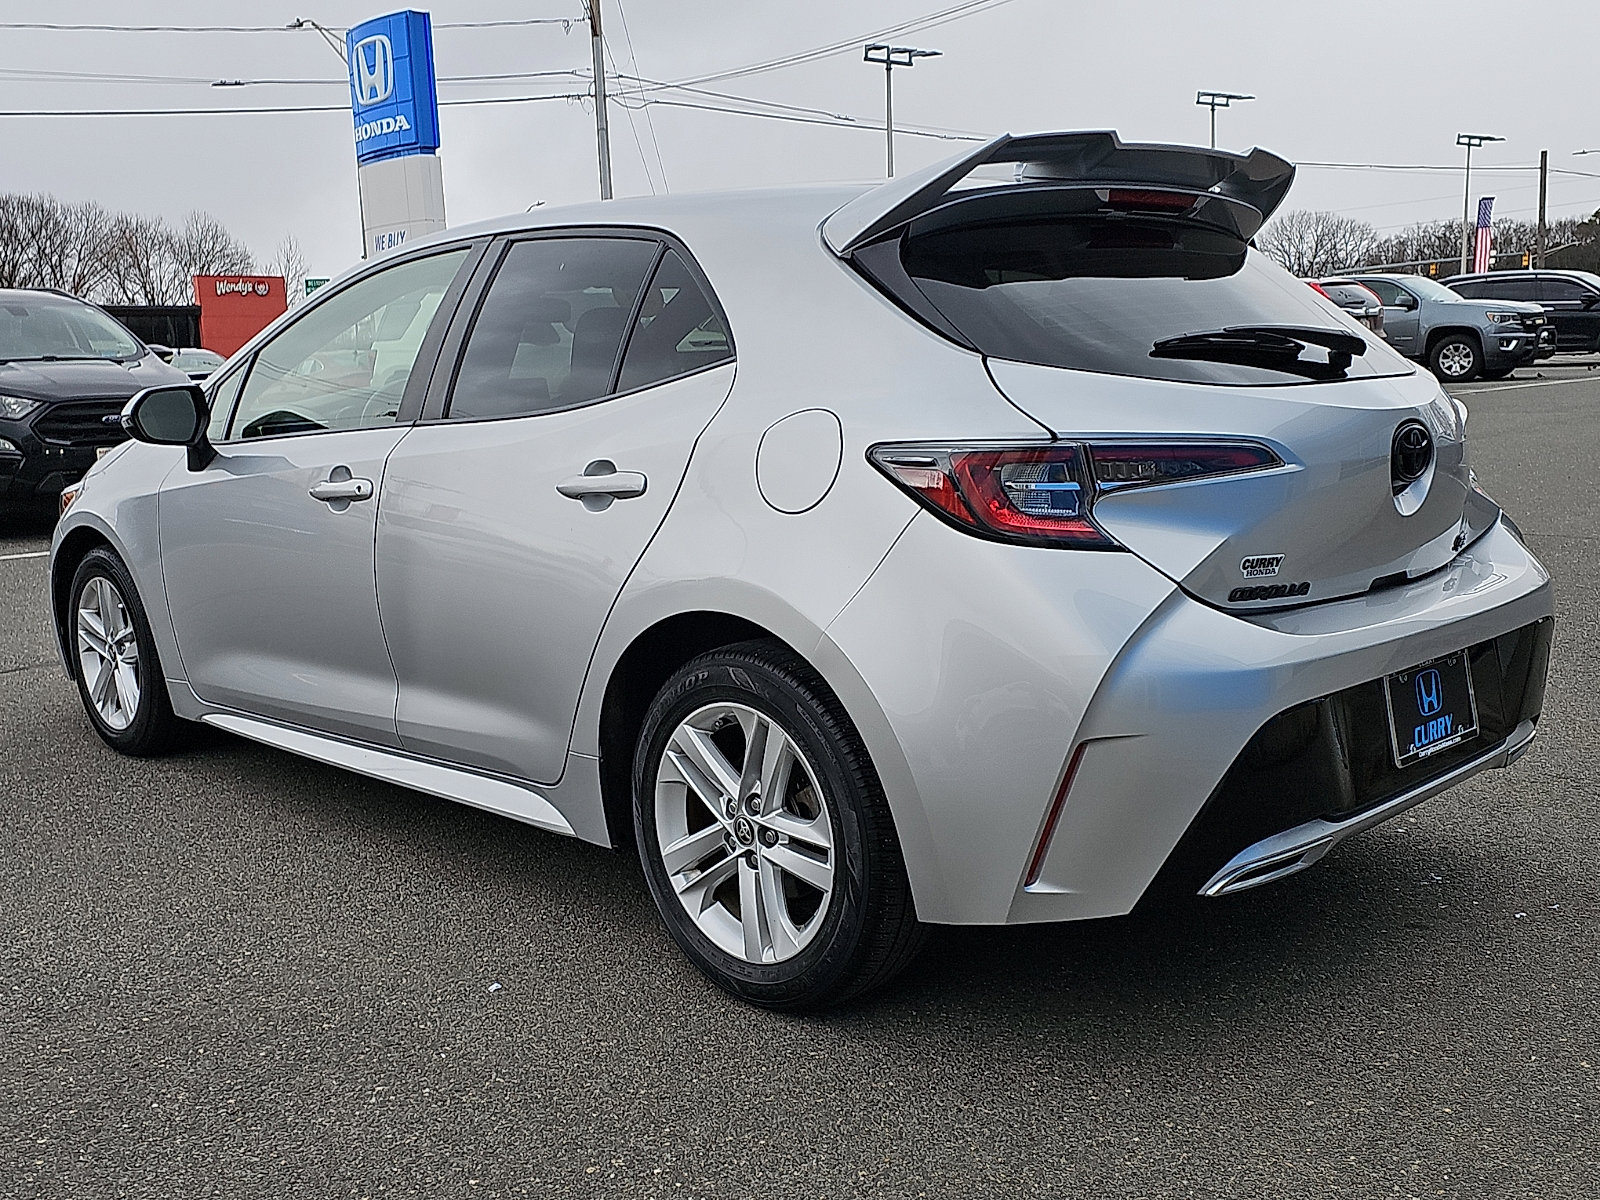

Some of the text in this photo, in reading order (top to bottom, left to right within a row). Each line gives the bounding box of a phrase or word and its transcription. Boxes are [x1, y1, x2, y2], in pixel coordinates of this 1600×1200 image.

[355, 115, 411, 142] HONDA
[374, 230, 406, 252] WE BUY
[216, 280, 252, 296] Wendy's
[1242, 556, 1283, 570] CURRY
[1245, 568, 1276, 577] HONDA
[1414, 713, 1453, 748] CURRY
